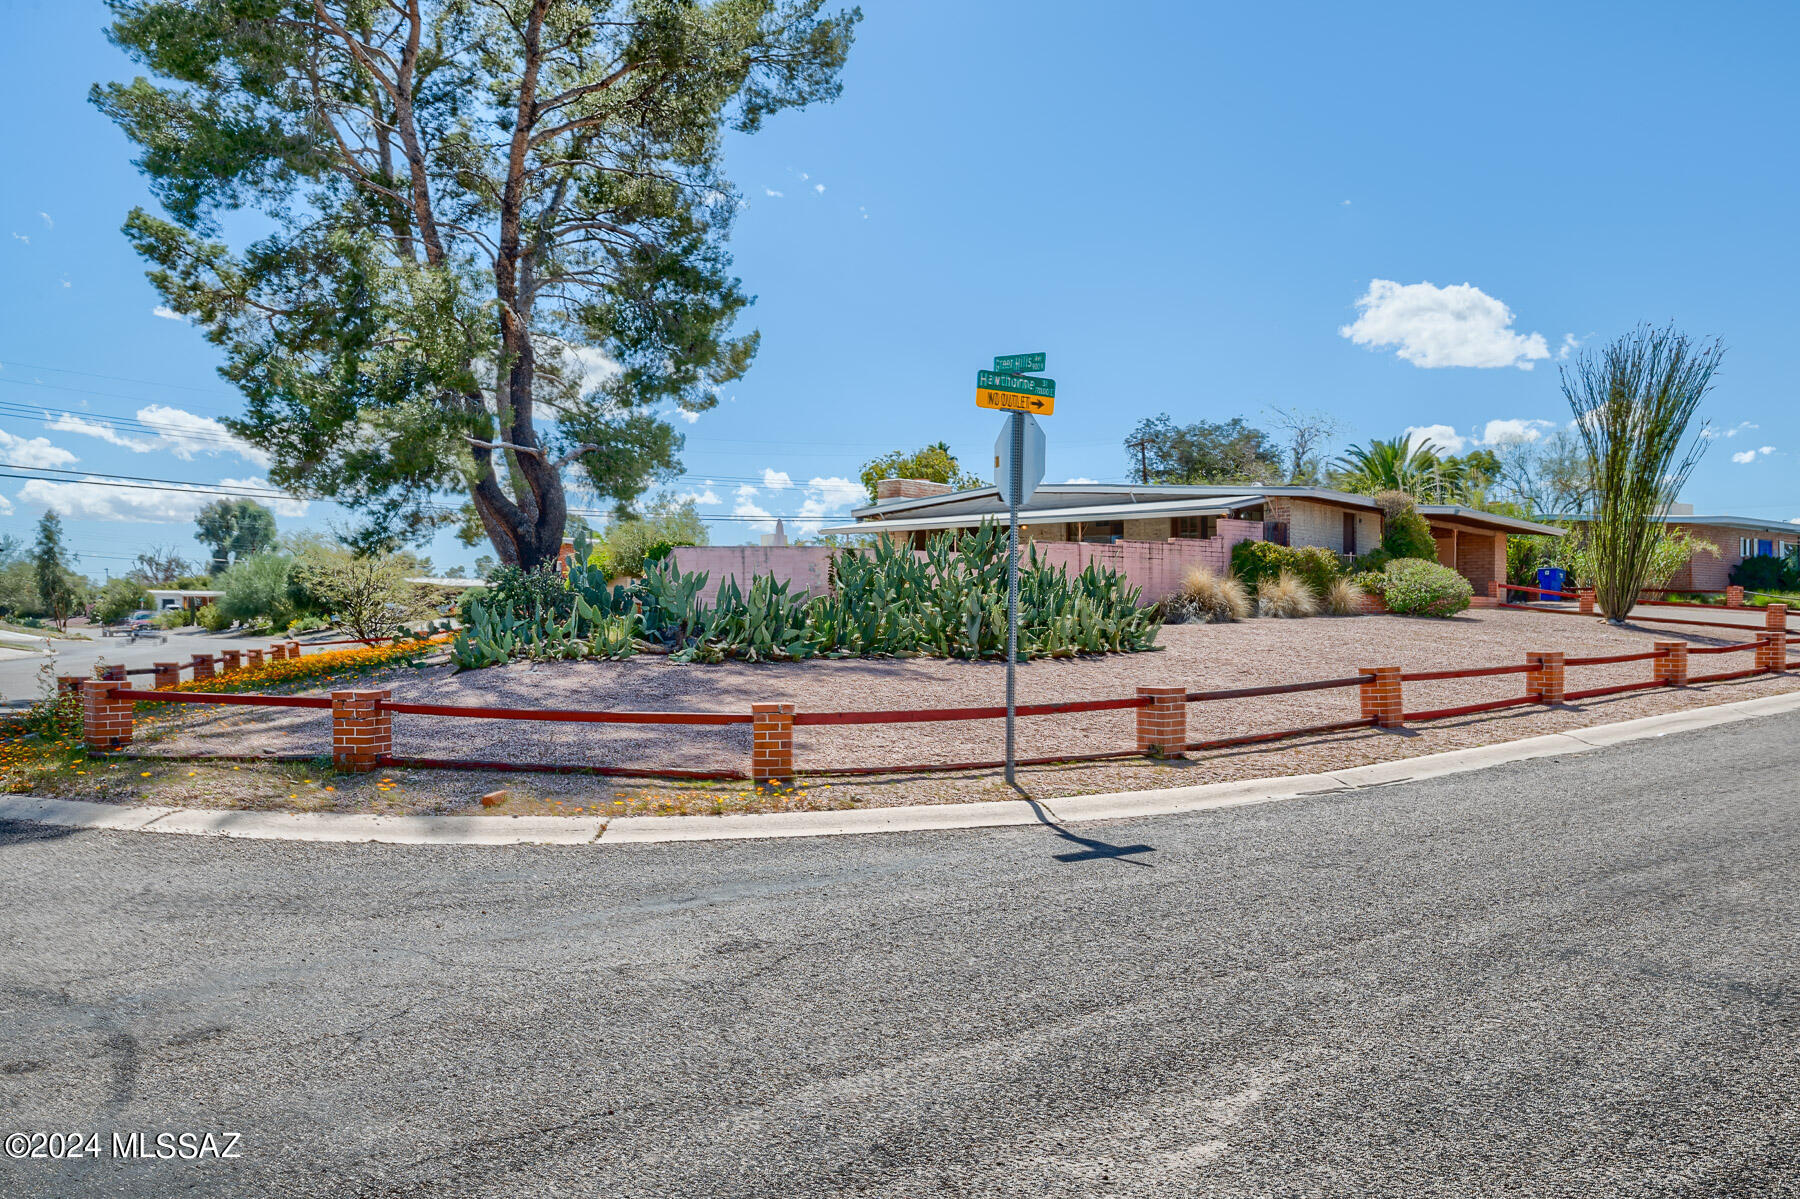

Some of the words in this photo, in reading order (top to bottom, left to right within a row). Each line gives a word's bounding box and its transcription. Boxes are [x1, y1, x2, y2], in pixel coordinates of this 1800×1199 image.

[1015, 356, 1032, 370] Hills
[980, 372, 1035, 391] Hawthorne
[988, 392, 999, 406] NO
[1001, 393, 1031, 409] OUTLET
